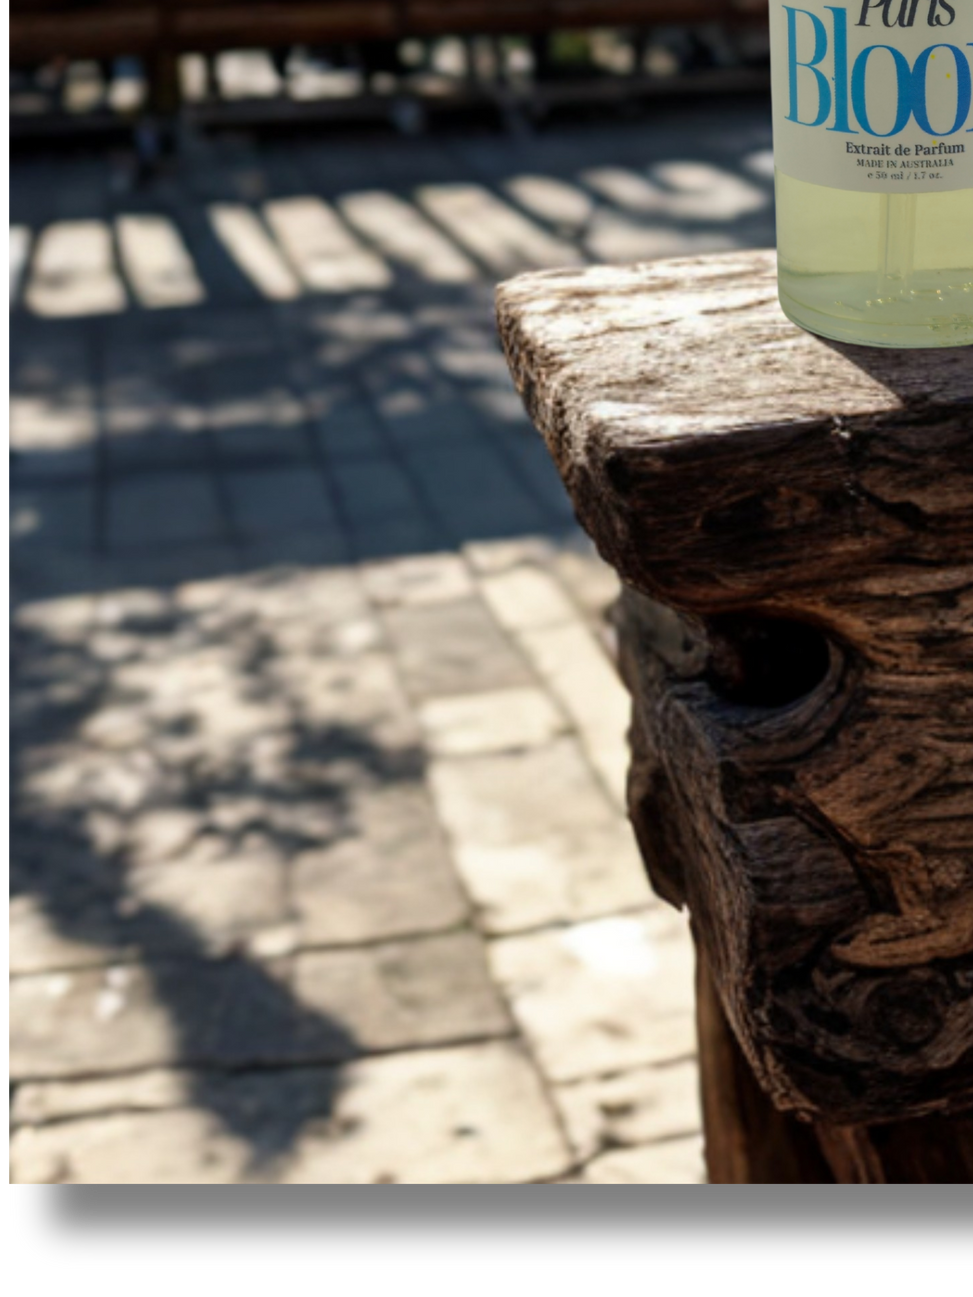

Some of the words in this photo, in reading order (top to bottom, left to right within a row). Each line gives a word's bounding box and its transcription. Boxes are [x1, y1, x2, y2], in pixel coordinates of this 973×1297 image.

[845, 141, 891, 156] Extrait
[894, 143, 911, 156] de
[914, 142, 965, 156] Parfum
[856, 158, 884, 169] MADE
[886, 159, 898, 169] IN
[899, 158, 954, 169] AUSTRALIA
